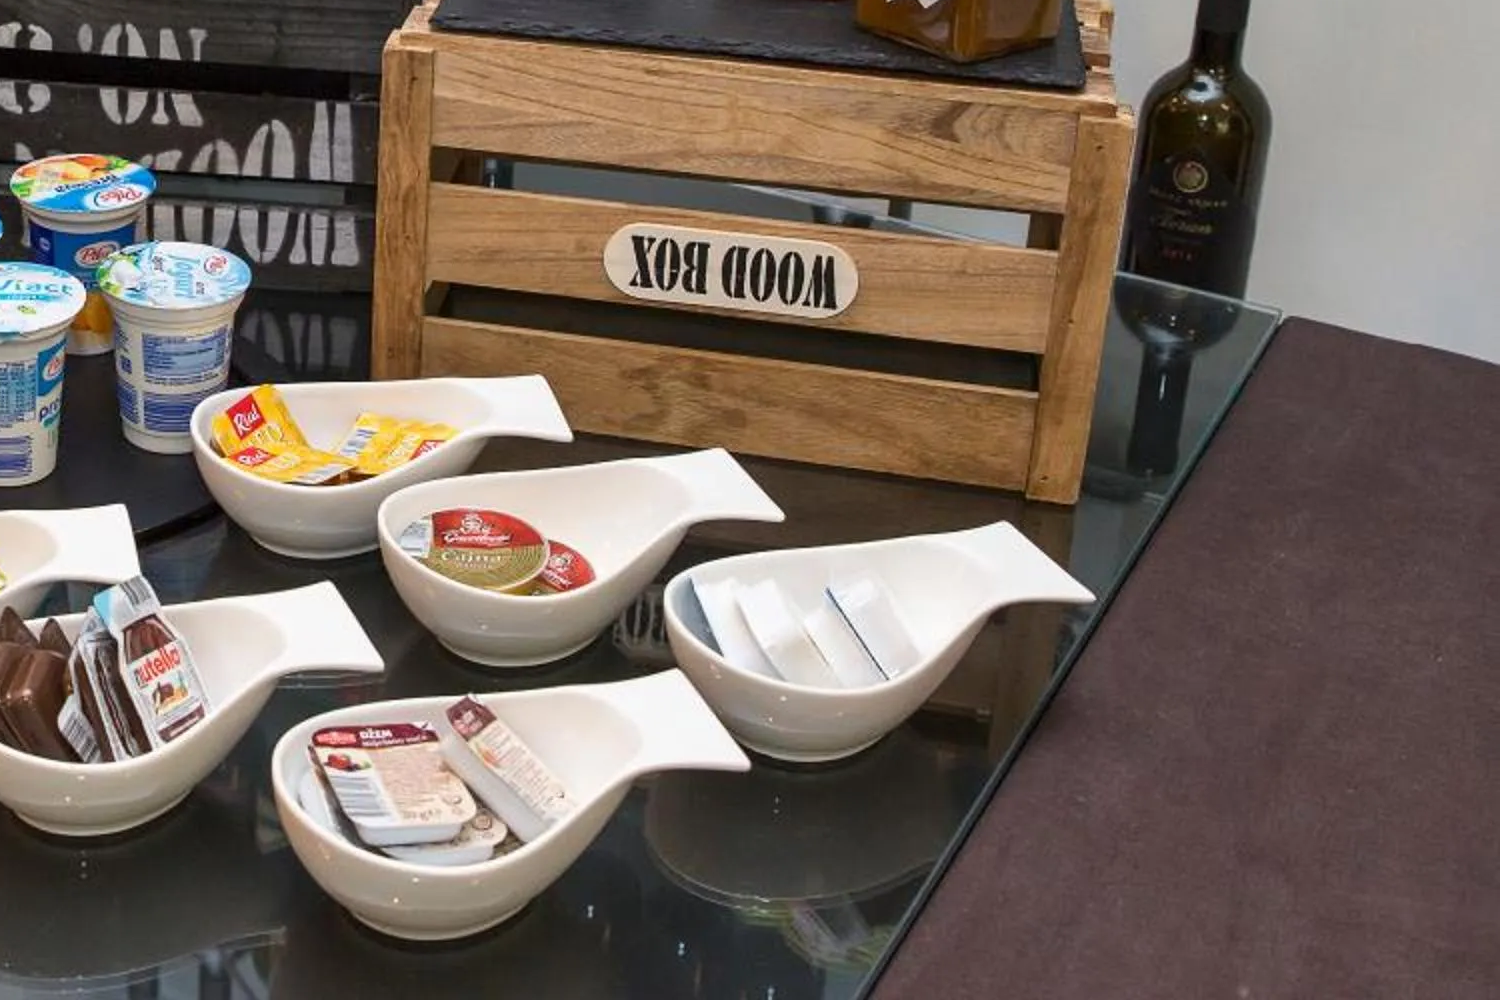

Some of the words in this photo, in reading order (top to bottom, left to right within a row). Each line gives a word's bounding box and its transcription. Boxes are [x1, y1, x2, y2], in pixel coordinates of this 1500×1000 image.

[628, 234, 712, 296] BOX
[720, 244, 838, 311] WOOD
[133, 647, 183, 690] nutella
